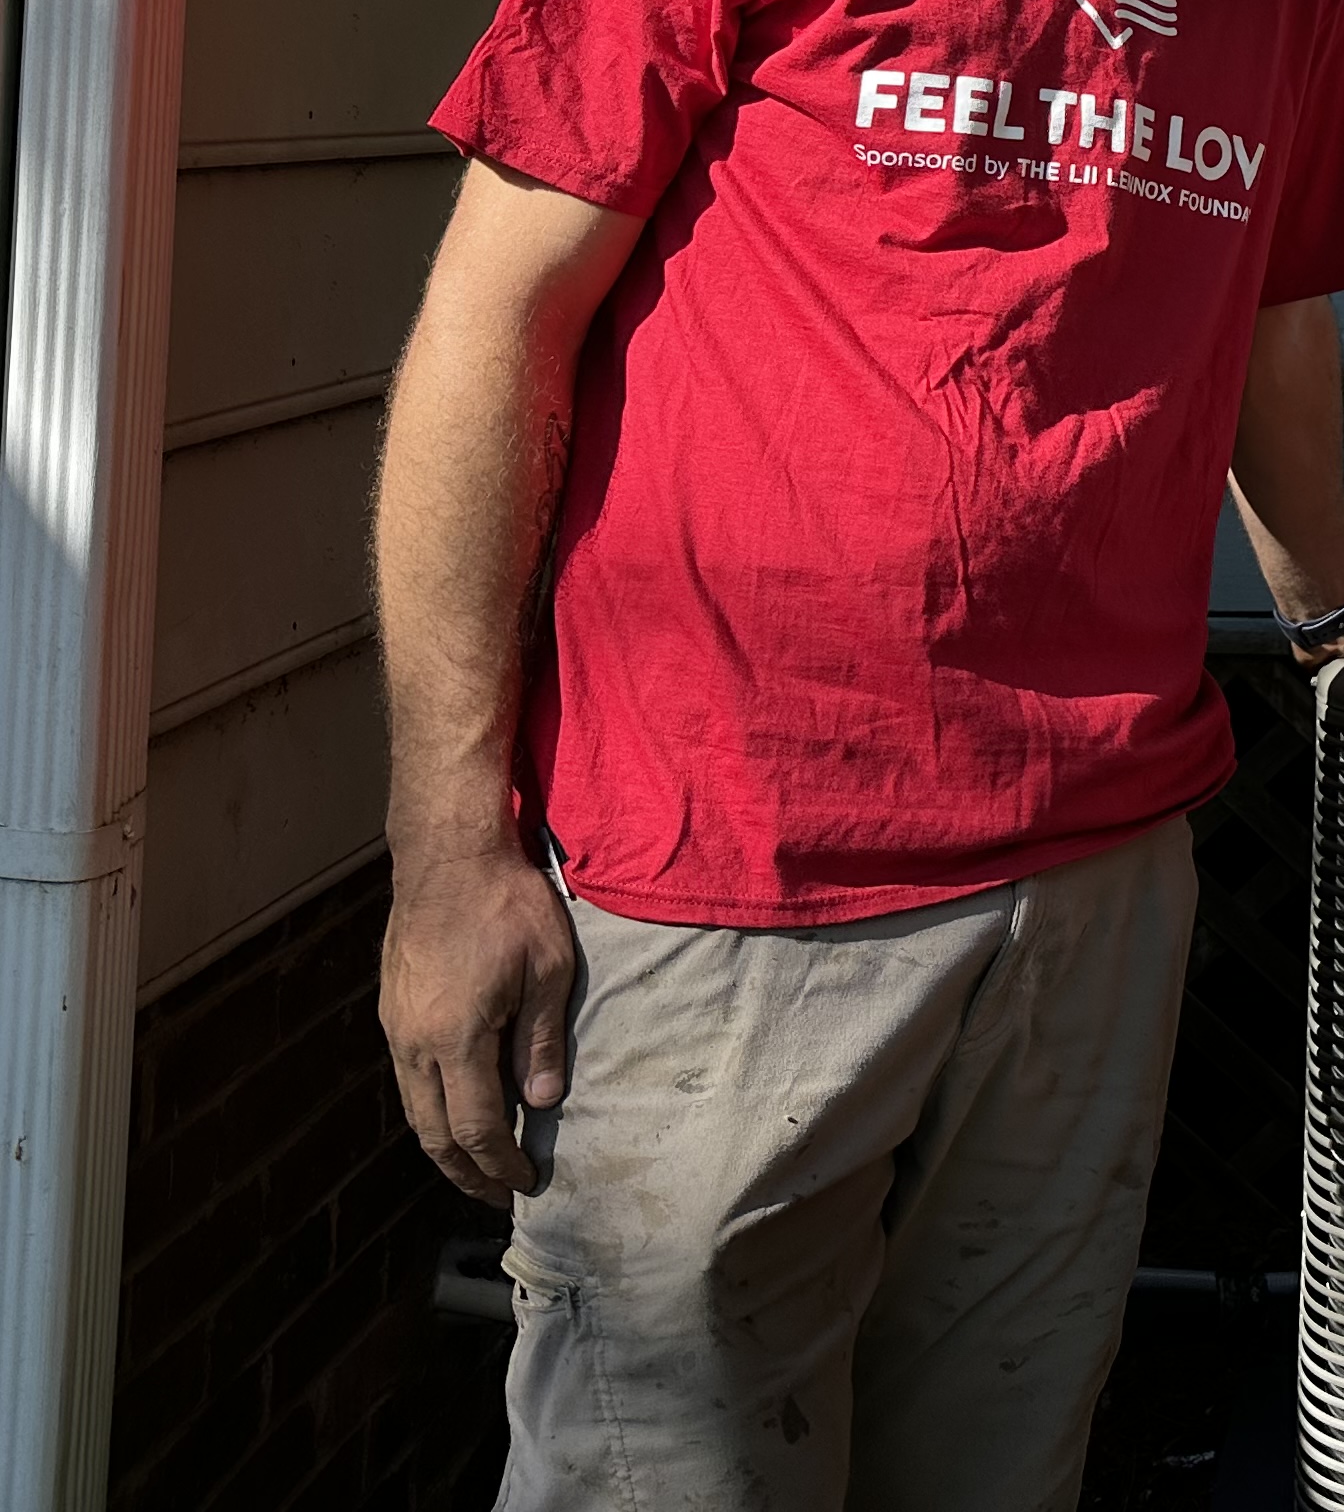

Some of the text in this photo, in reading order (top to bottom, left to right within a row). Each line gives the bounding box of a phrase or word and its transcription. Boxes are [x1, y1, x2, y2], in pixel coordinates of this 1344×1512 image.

[855, 69, 1266, 191] FEEL THE LOV
[853, 143, 977, 173] Sponsored
[984, 156, 1010, 180] by
[1017, 157, 1061, 182] THE
[1069, 163, 1098, 185] LII
[1178, 188, 1251, 224] FOUNDA
